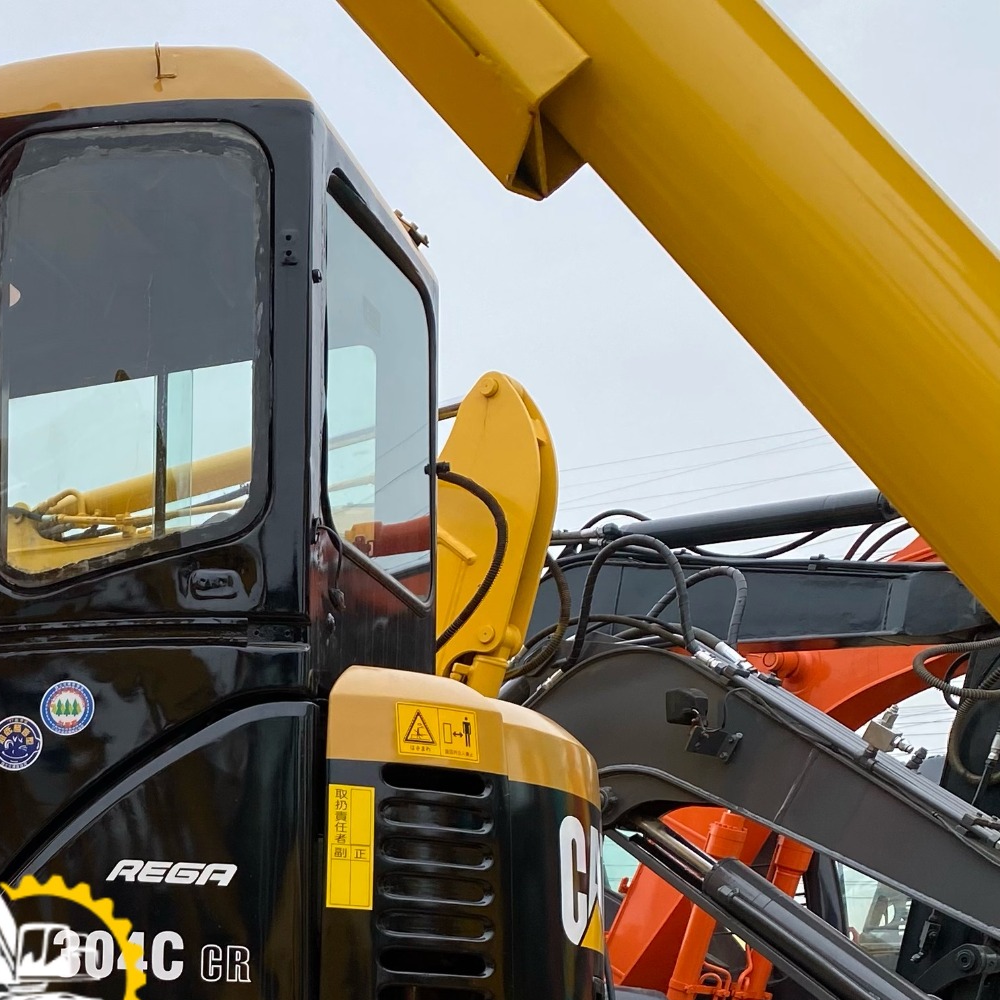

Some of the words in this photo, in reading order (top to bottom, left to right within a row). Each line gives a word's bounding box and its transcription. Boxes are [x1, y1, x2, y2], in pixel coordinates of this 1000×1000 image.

[354, 848, 367, 860] 正
[105, 859, 238, 887] REGA
[200, 944, 251, 982] CR
